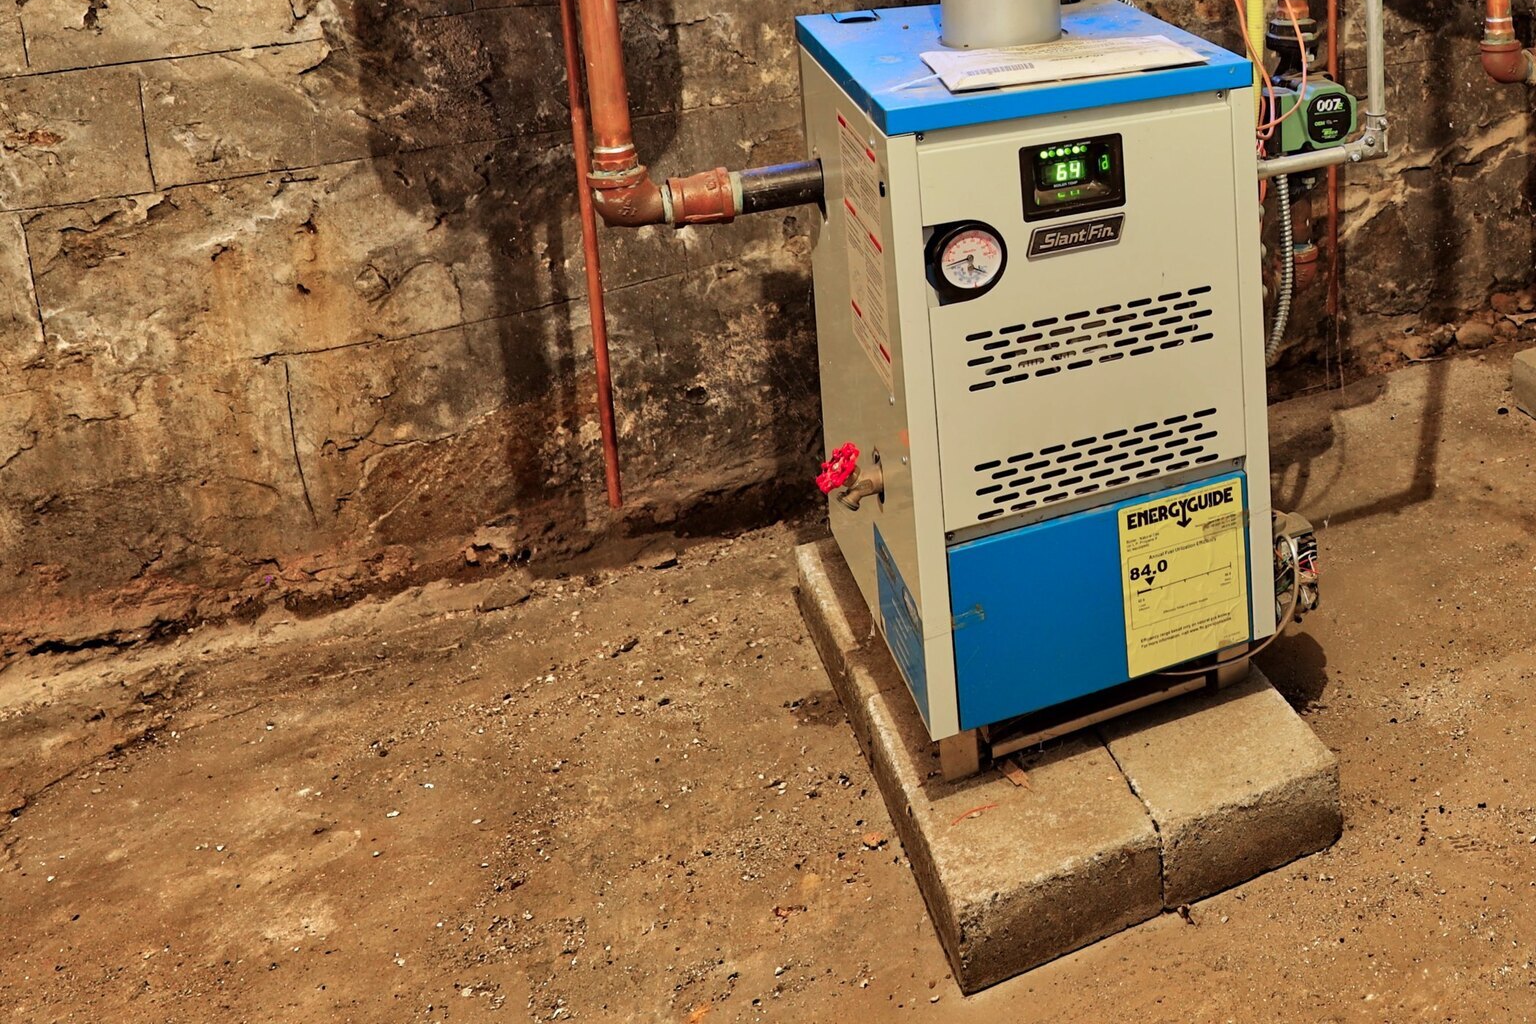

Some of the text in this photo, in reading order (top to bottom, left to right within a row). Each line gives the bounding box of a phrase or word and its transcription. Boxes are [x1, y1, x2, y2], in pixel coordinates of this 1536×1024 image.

[1056, 160, 1080, 181] 64
[1127, 486, 1233, 530] ENERGYGUIDE
[1130, 559, 1167, 581] 84.0
